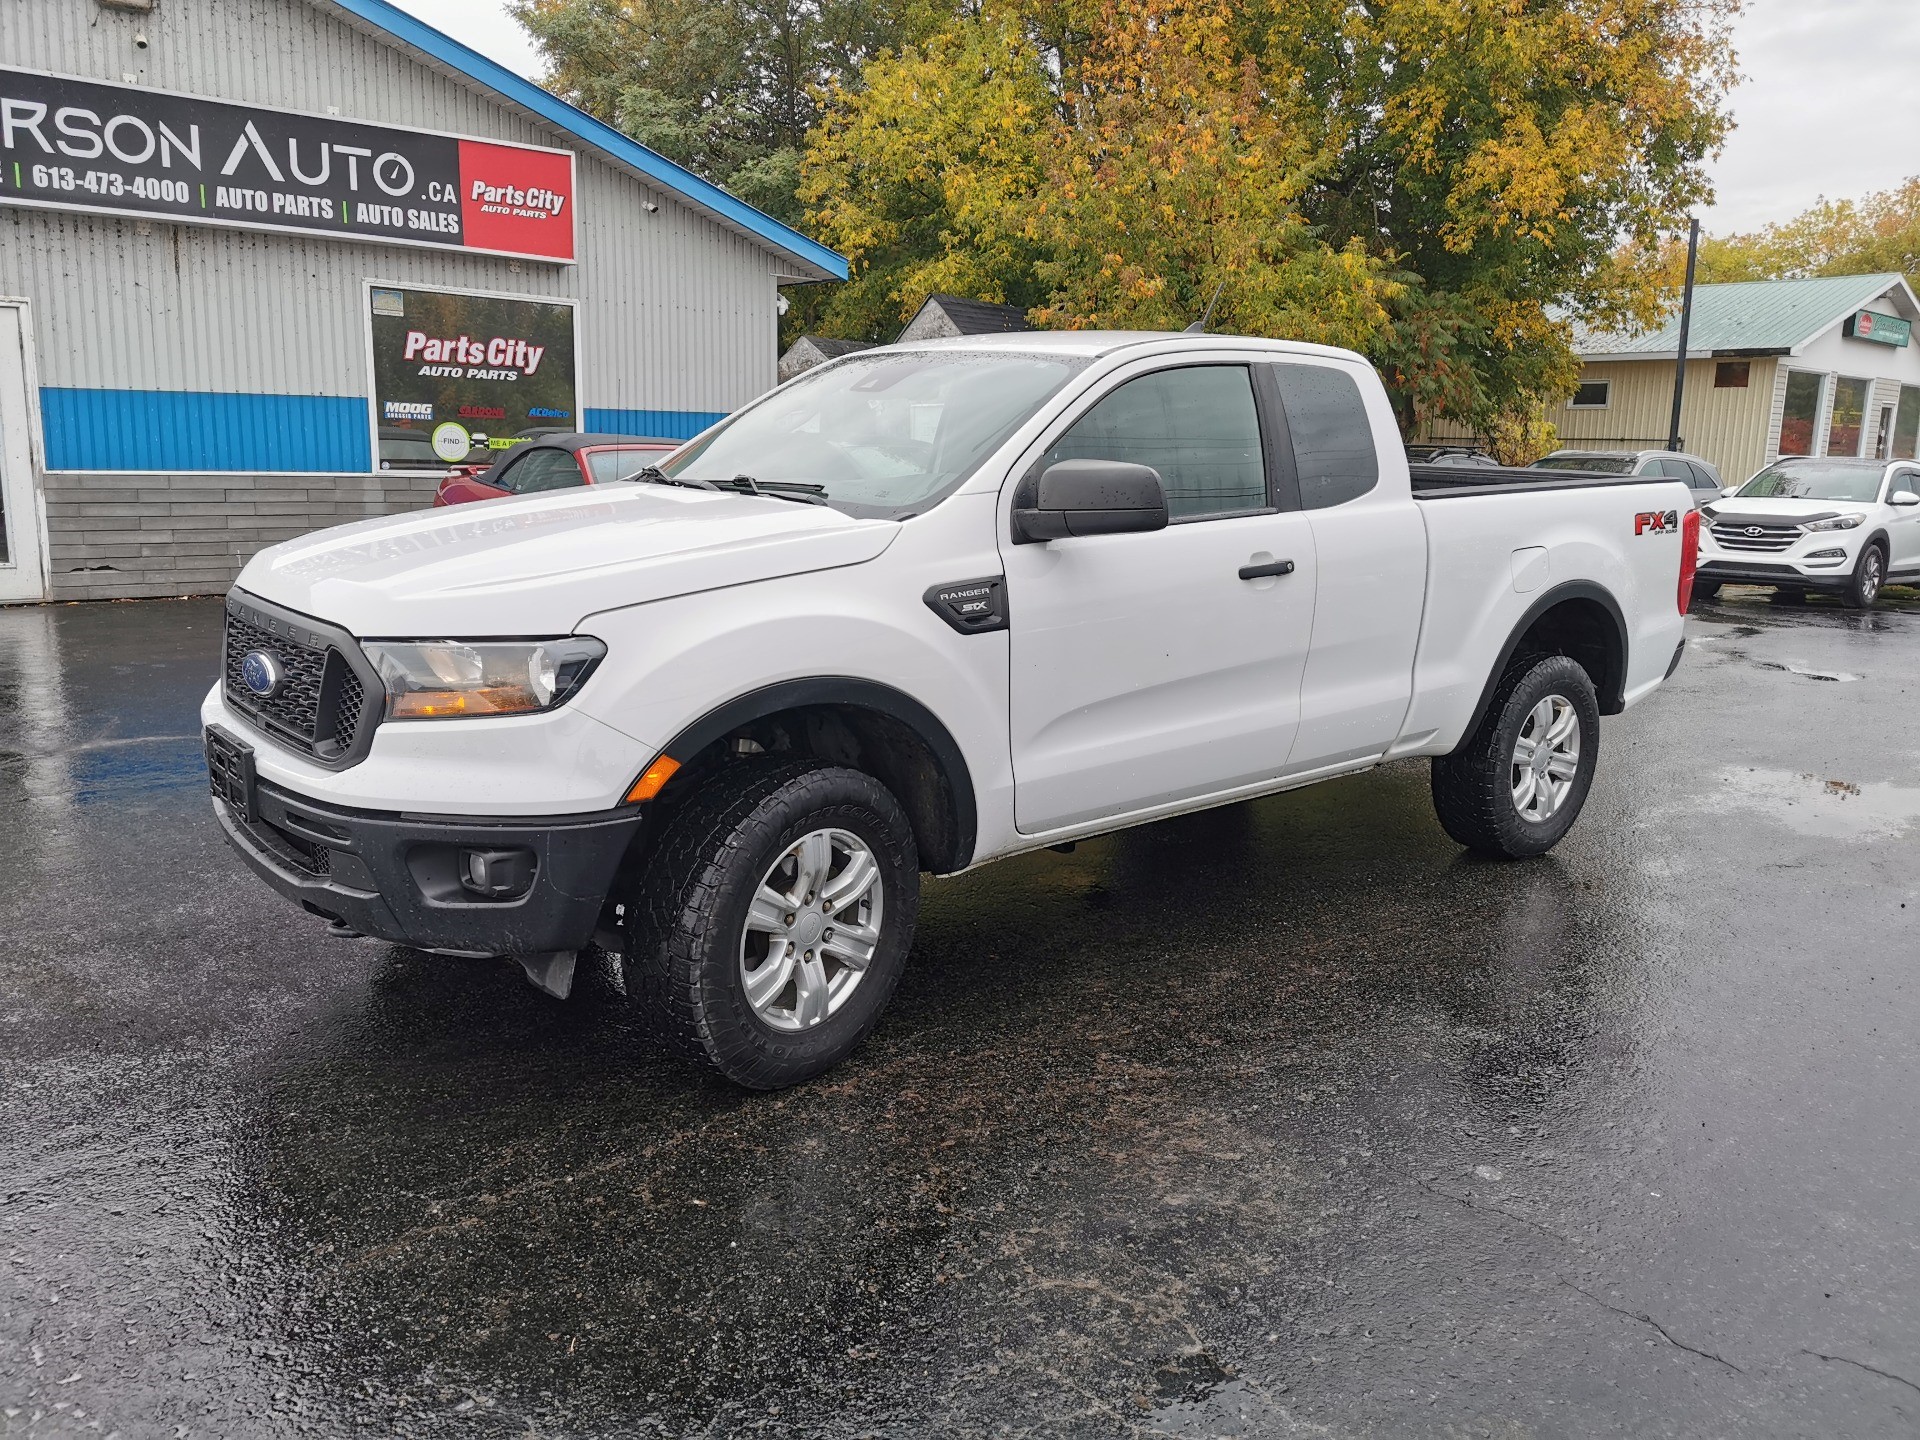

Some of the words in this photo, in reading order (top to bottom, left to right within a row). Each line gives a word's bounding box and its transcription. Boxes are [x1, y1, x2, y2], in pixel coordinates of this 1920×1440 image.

[1, 98, 201, 171] RSON
[221, 119, 414, 197] AUTO
[32, 164, 190, 203] 613-473-4000
[215, 186, 267, 211] AUTO
[273, 192, 333, 219] PARTS
[357, 203, 403, 227] AUTO
[407, 208, 459, 234] SALES
[481, 205, 510, 216] AUTO
[512, 208, 547, 219] PARTS
[418, 366, 463, 378] AUTO
[466, 368, 518, 381] PARTS
[385, 401, 433, 414] MOOG
[443, 437, 460, 445] FIND
[1634, 510, 1678, 536] FX4
[940, 587, 990, 600] RANGER
[961, 601, 988, 612] STX
